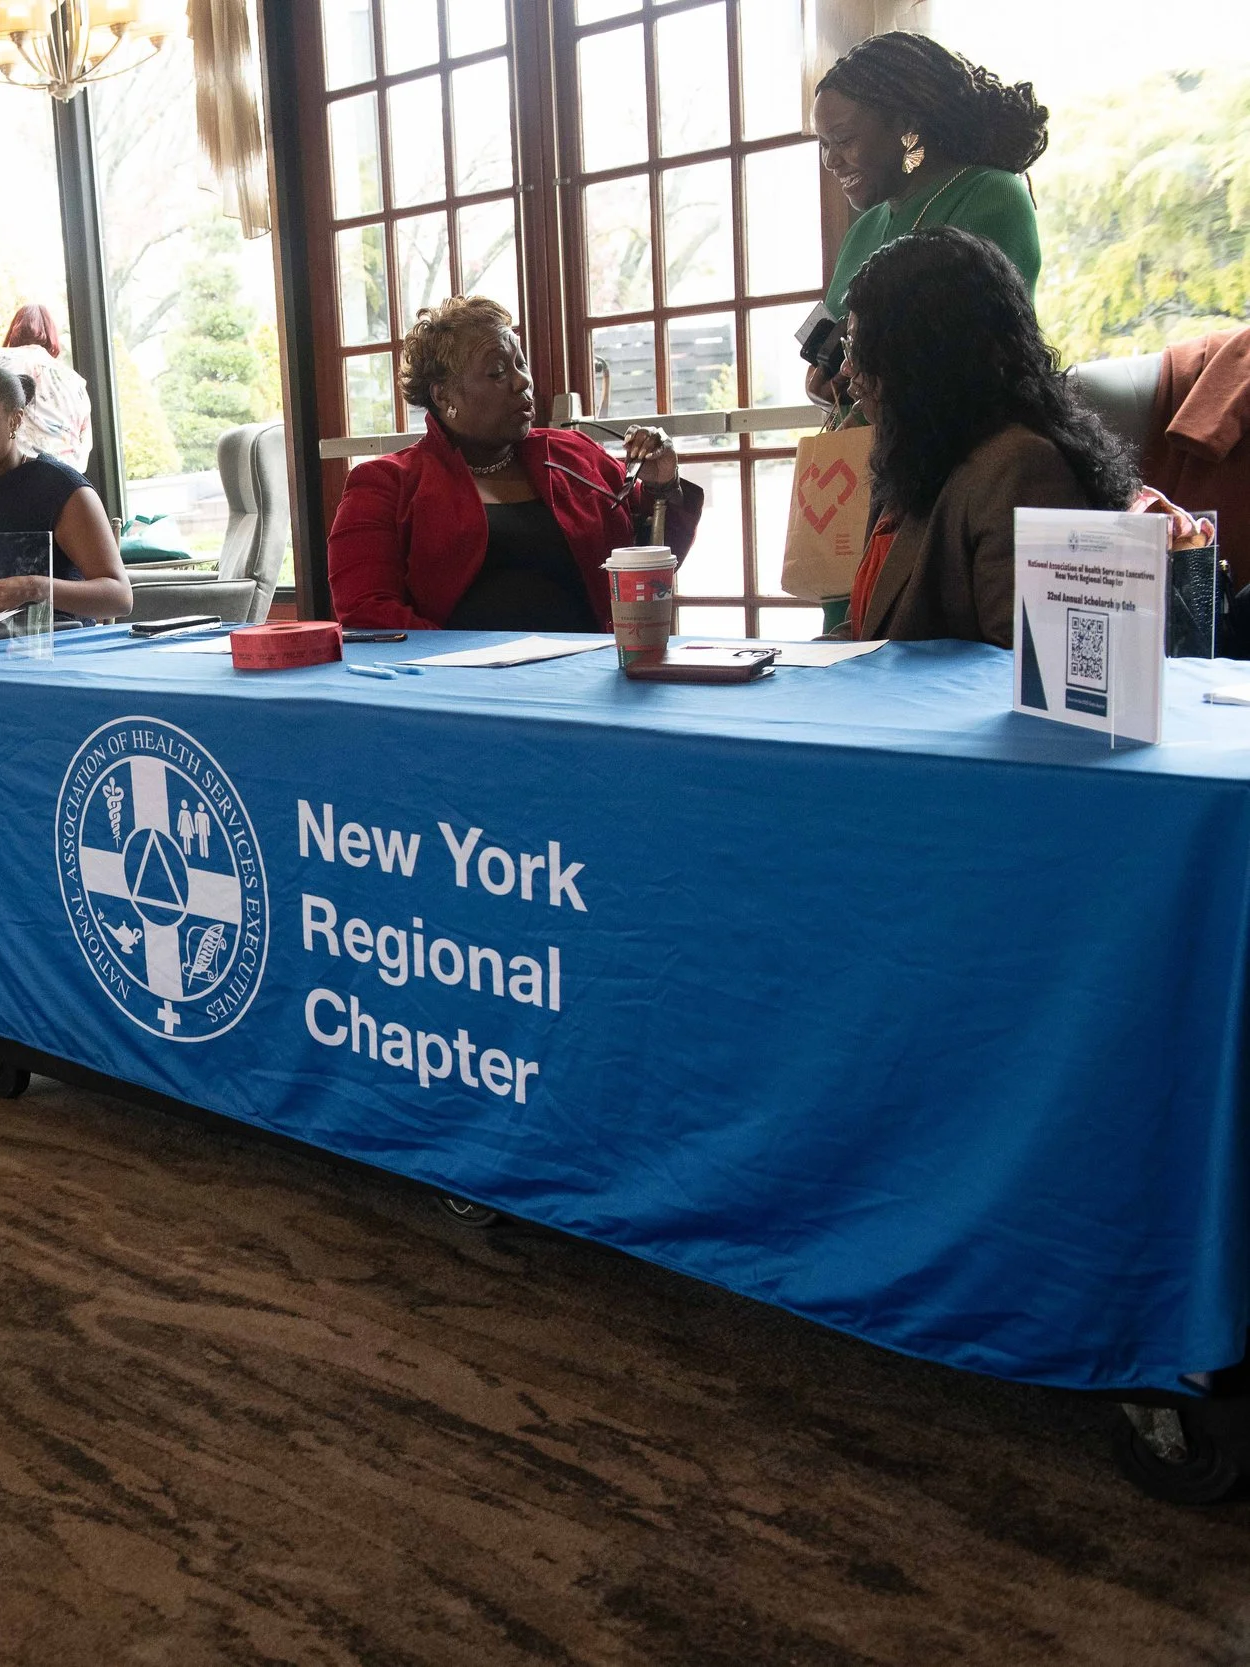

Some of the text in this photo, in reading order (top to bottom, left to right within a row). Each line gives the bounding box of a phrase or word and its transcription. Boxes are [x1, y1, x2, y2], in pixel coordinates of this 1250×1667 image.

[1027, 559, 1049, 569] National
[1049, 561, 1078, 572] Association
[1084, 565, 1102, 575] Health
[1055, 571, 1067, 580] New
[1067, 573, 1079, 581] York
[1079, 574, 1102, 585] Regional
[1062, 593, 1084, 605] Annual
[63, 729, 261, 1023] NATIONAL ASSOCIATION OF HEALTH SERVICES EXECUTIVES
[297, 799, 588, 912] New York
[301, 892, 561, 1012] Regional
[304, 987, 540, 1105] Chapter
